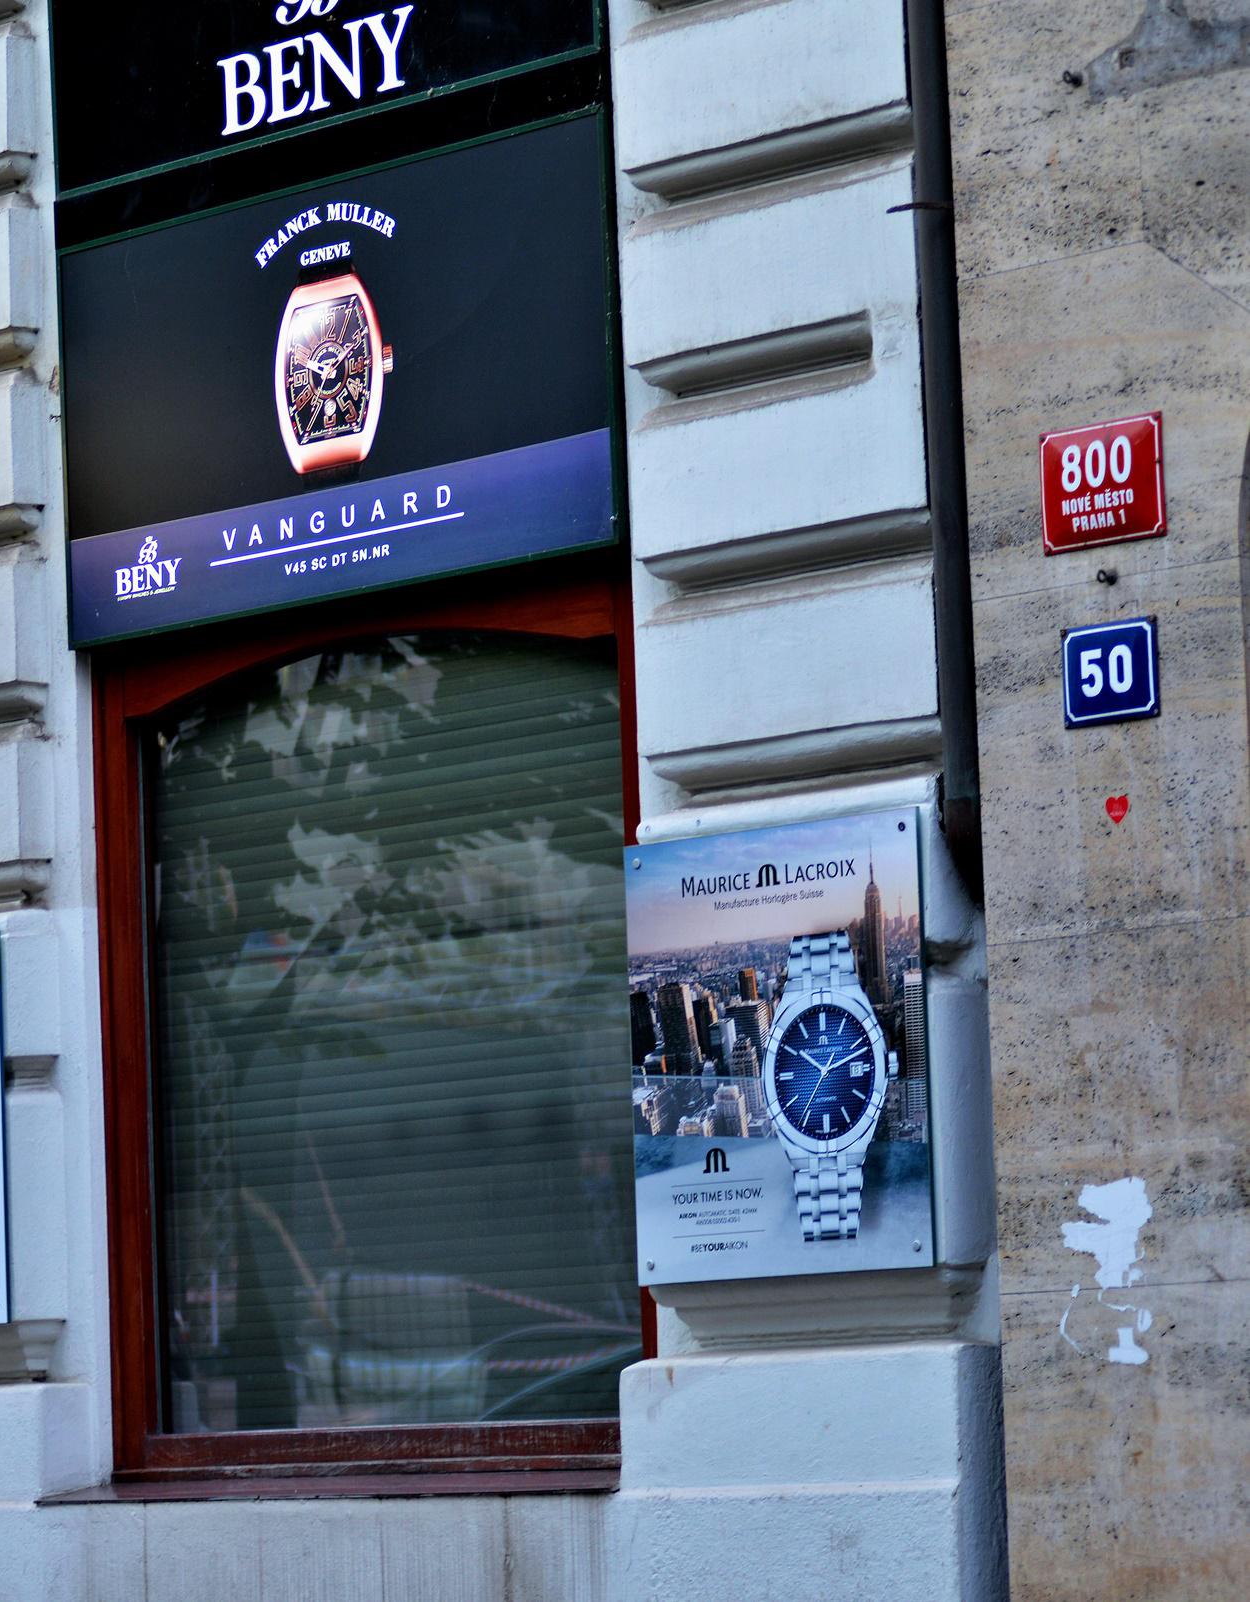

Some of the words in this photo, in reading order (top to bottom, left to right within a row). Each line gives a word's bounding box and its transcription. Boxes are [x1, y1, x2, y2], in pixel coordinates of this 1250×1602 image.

[217, 5, 413, 136] BENY
[255, 207, 322, 269] FRANCK
[326, 202, 396, 238] MULLER
[300, 241, 351, 267] GENEVE
[1062, 435, 1132, 493] 800
[222, 484, 452, 551] VANGUARD
[1062, 492, 1091, 516] NOVÉ
[1094, 488, 1134, 510] MĚSTO
[1072, 511, 1115, 533] PRAHA
[1119, 508, 1126, 525] 1
[115, 557, 182, 596] BENY
[285, 562, 307, 576] V45
[311, 556, 327, 571] SC
[332, 552, 347, 565] DT
[352, 544, 390, 563] 5N.NR
[1080, 644, 1133, 698] 50
[681, 872, 750, 898] MAURICE
[785, 858, 856, 884] LACROIX
[714, 898, 759, 911] Manufacture
[761, 893, 798, 906] Horlogère
[800, 889, 824, 900] Suisse
[672, 1191, 698, 1205] YOUR
[700, 1190, 723, 1203] TIME
[725, 1188, 734, 1201] IS
